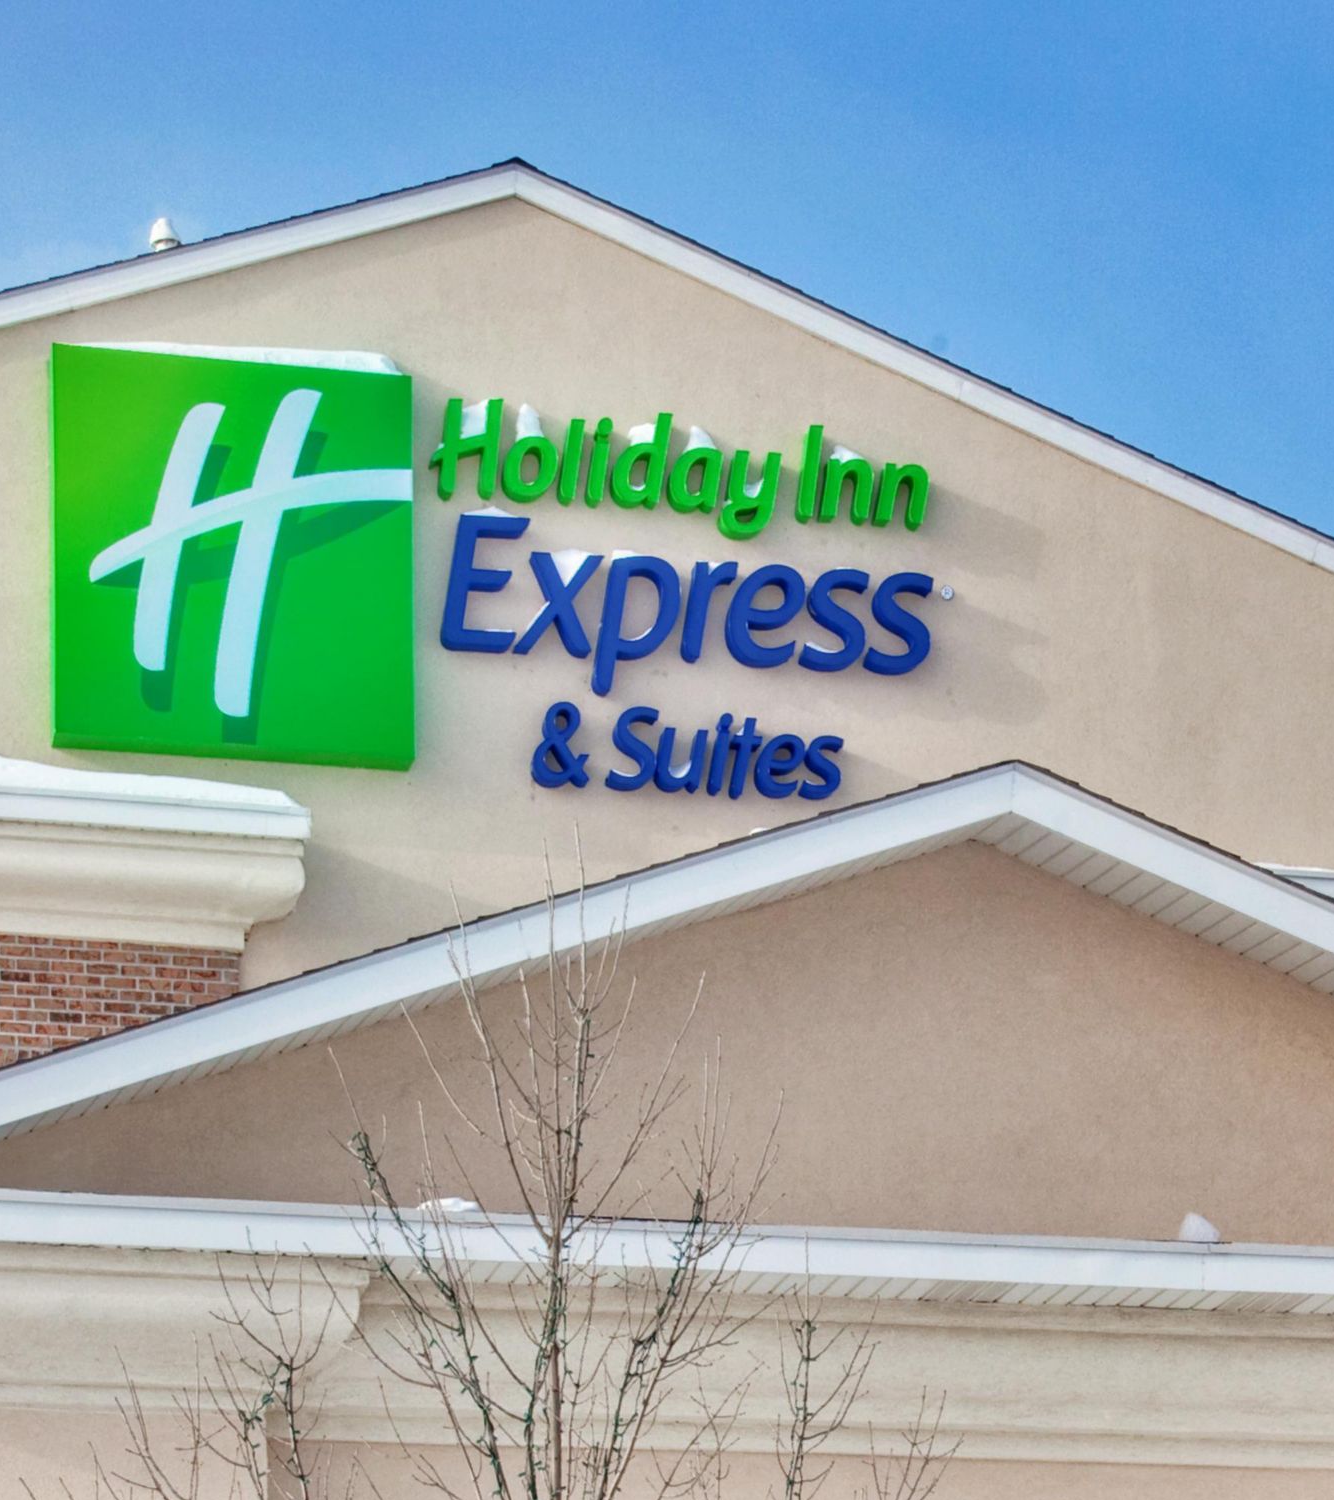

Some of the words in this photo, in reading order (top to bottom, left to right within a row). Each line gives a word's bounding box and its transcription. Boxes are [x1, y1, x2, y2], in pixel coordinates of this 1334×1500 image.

[429, 398, 782, 540] Holiday
[795, 425, 931, 531] Inn
[440, 514, 934, 697] Express
[531, 701, 589, 788] &
[605, 706, 844, 800] Suites
